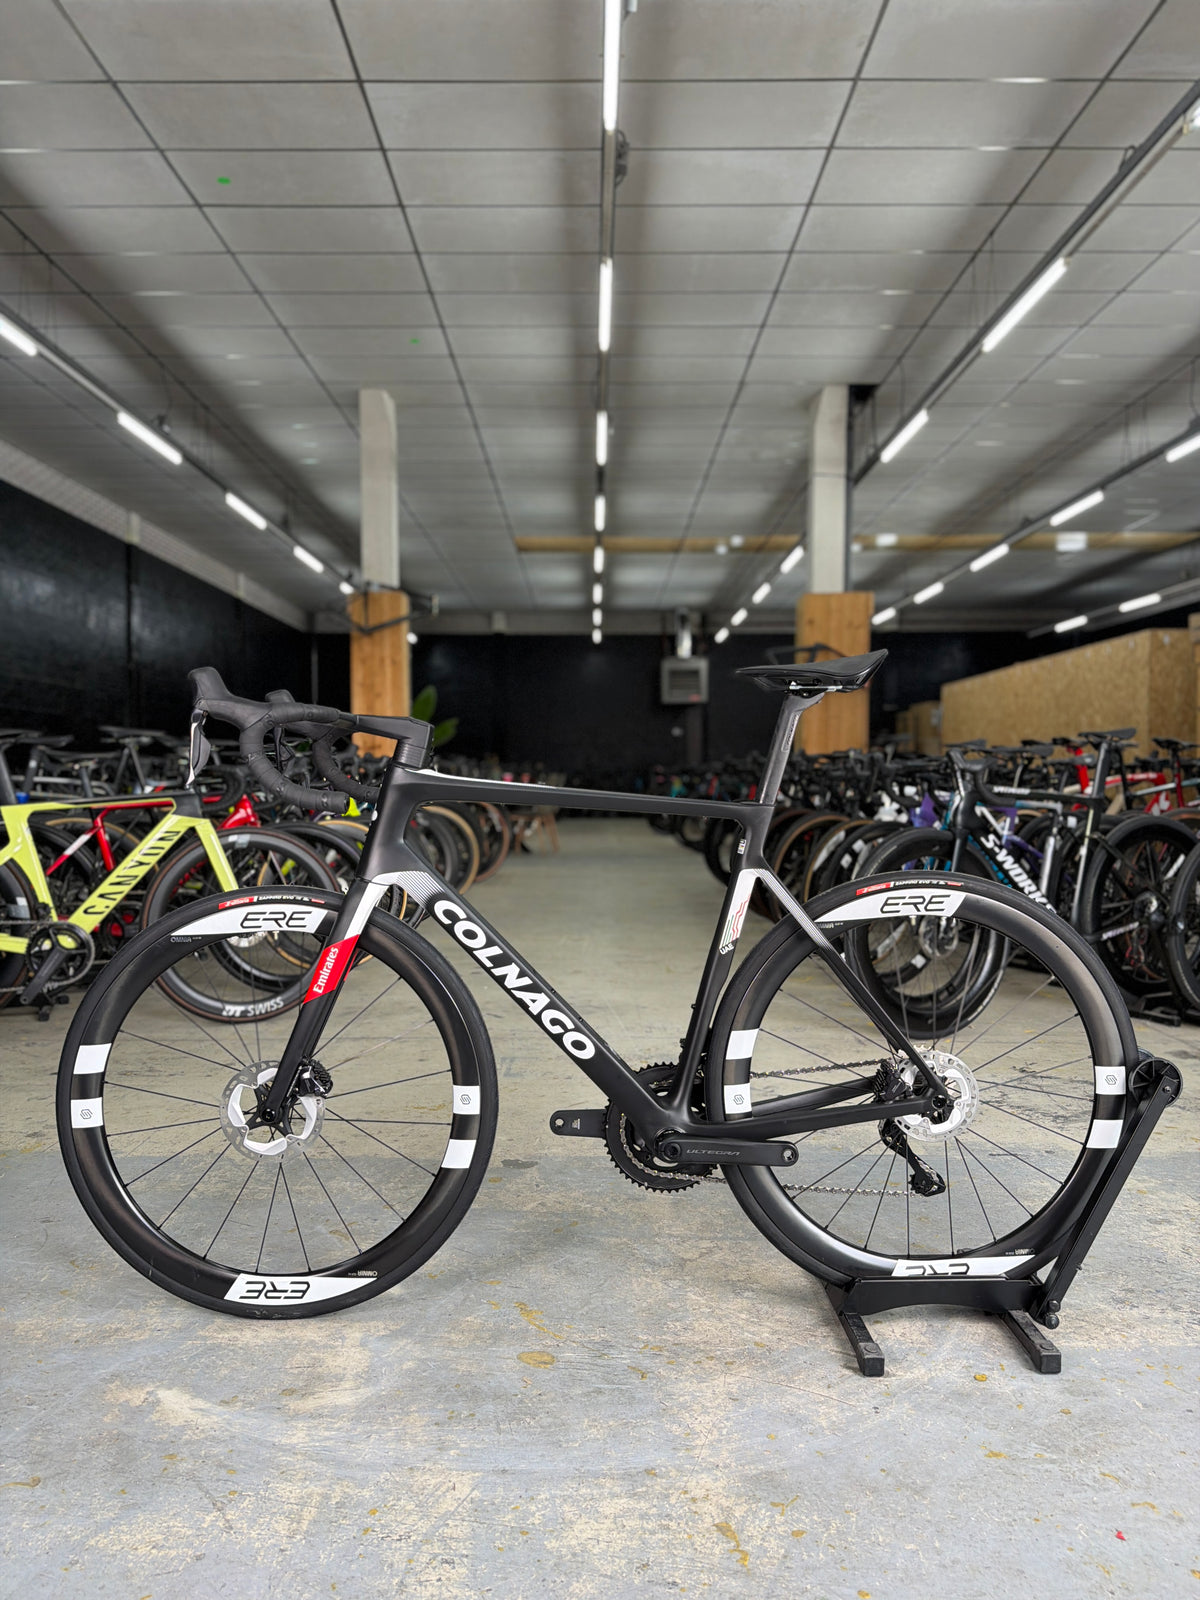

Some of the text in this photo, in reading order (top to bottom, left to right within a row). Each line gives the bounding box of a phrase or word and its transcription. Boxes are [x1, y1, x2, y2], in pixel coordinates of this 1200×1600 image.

[83, 830, 181, 915] CANYON
[980, 834, 1057, 914] S-WORK
[880, 894, 951, 914] ERE
[240, 911, 312, 929] ERE
[720, 943, 734, 955] UAE
[313, 947, 339, 994] Emirates
[434, 900, 595, 1060] COLNAGO
[222, 996, 284, 1017] DT SWISS
[239, 1281, 310, 1300] ERE
